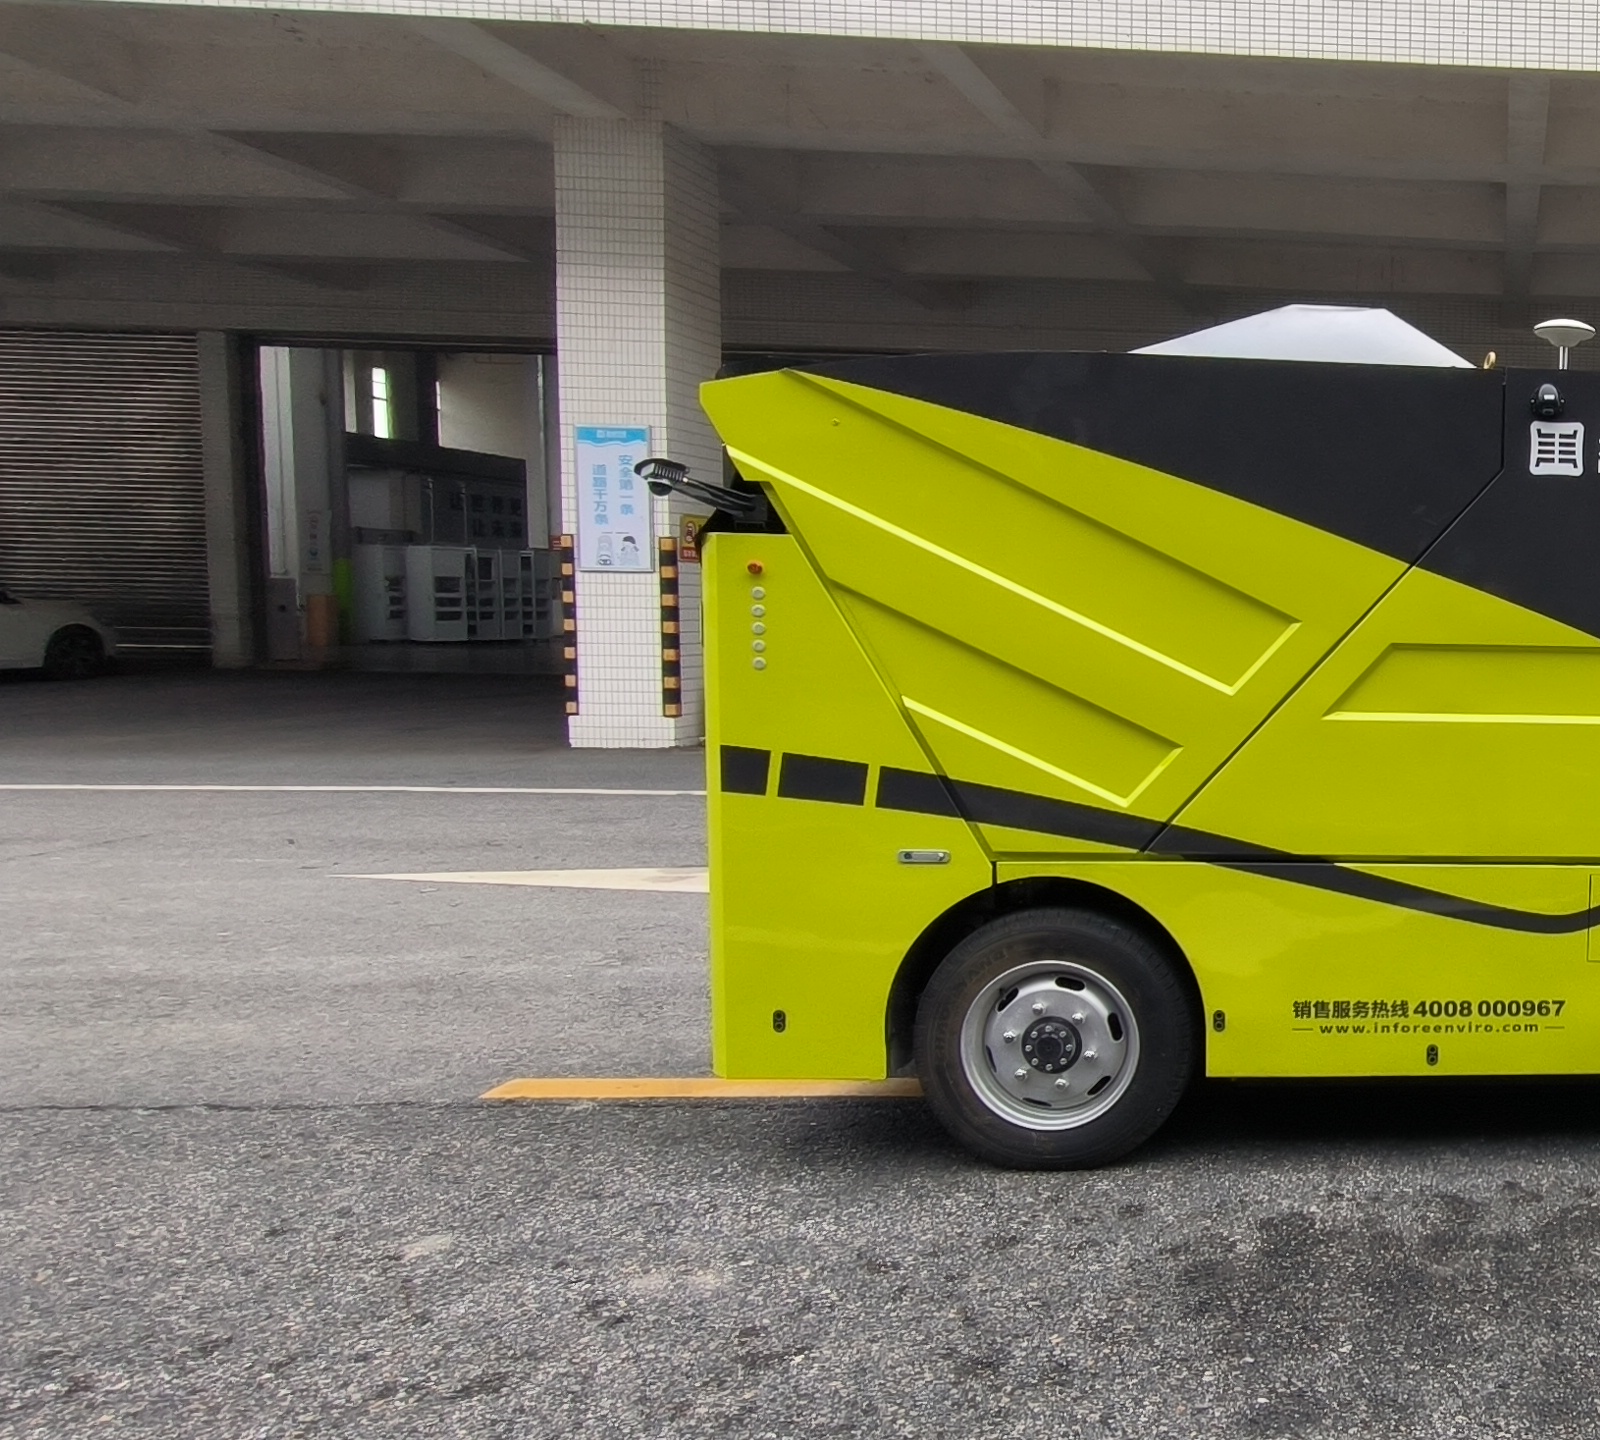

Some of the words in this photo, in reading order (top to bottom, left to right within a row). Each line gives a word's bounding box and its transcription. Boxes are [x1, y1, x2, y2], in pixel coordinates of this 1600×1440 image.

[618, 454, 634, 515] 安全第一条
[1292, 1000, 1409, 1019] 销售服务热线
[1319, 1021, 1540, 1034] www.inforeenviro.com
